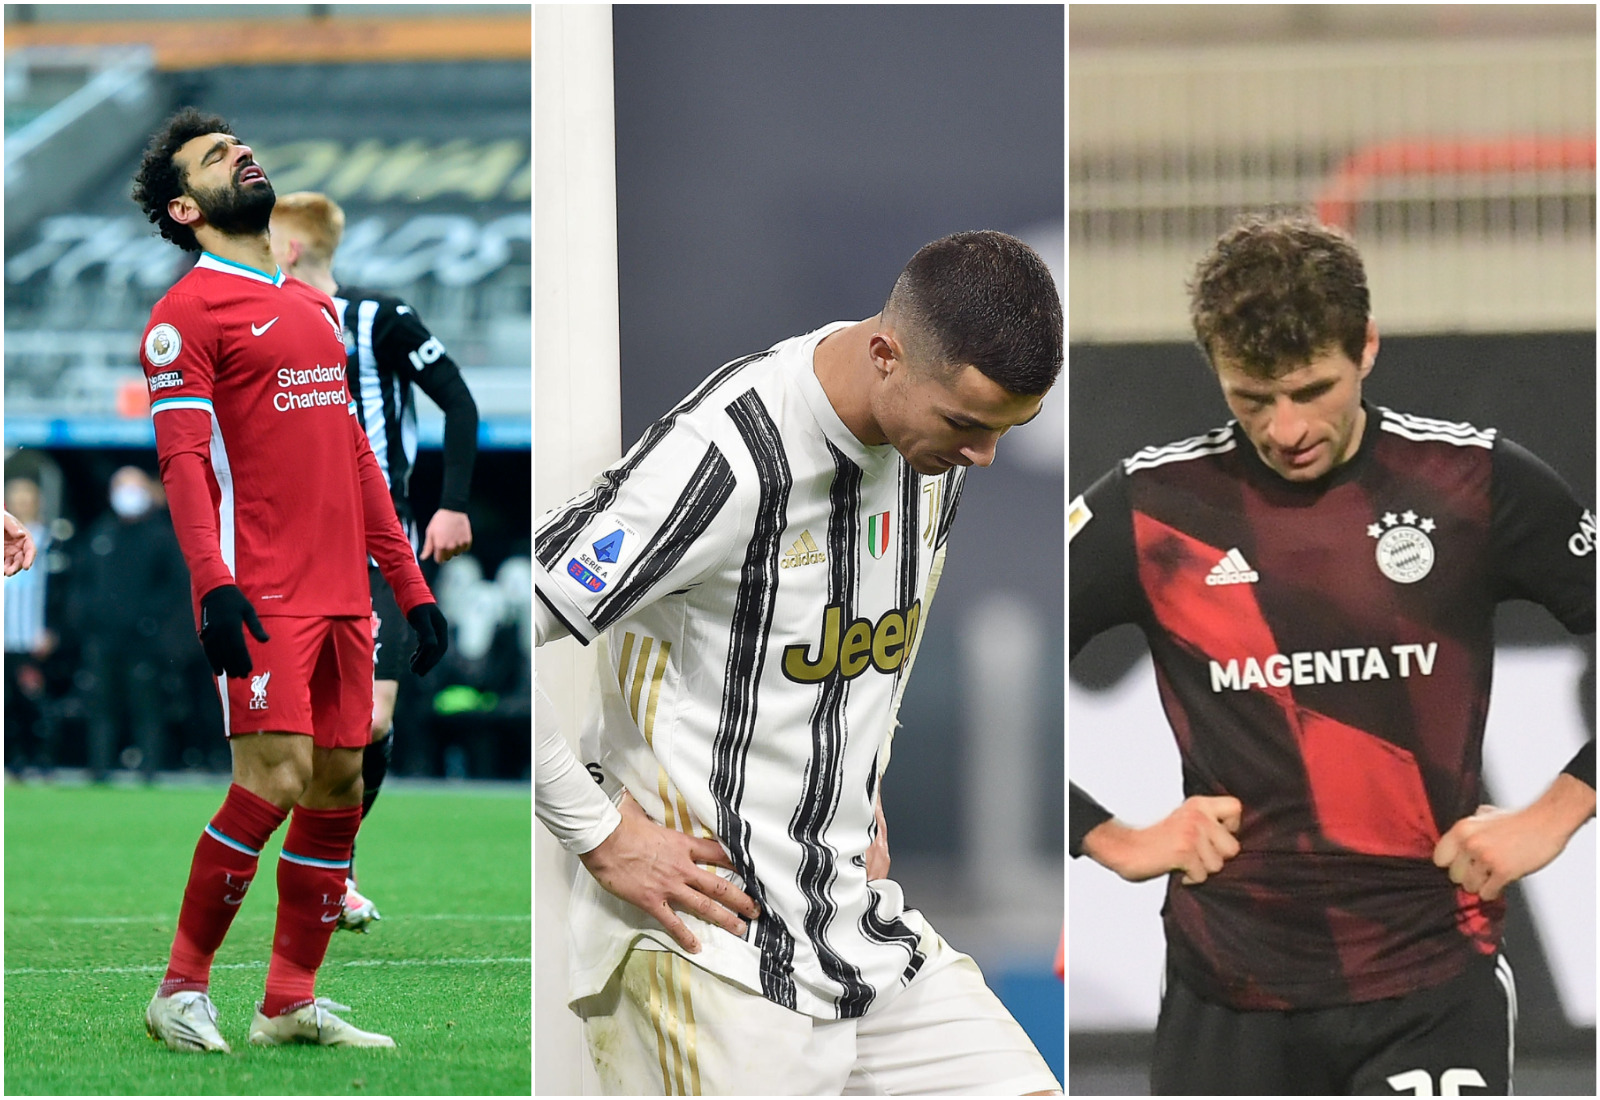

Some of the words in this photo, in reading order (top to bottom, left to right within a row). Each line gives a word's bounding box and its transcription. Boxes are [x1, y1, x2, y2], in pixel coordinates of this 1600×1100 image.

[277, 362, 344, 388] Standard
[273, 385, 347, 412] Chartered
[580, 553, 602, 574] SERIE
[600, 571, 608, 579] A
[780, 551, 826, 569] adidas
[581, 570, 602, 591] TIM
[1205, 570, 1260, 586] adidas
[781, 598, 921, 685] Jeep
[1208, 646, 1391, 693] MAGENTA
[1391, 641, 1439, 678] TV
